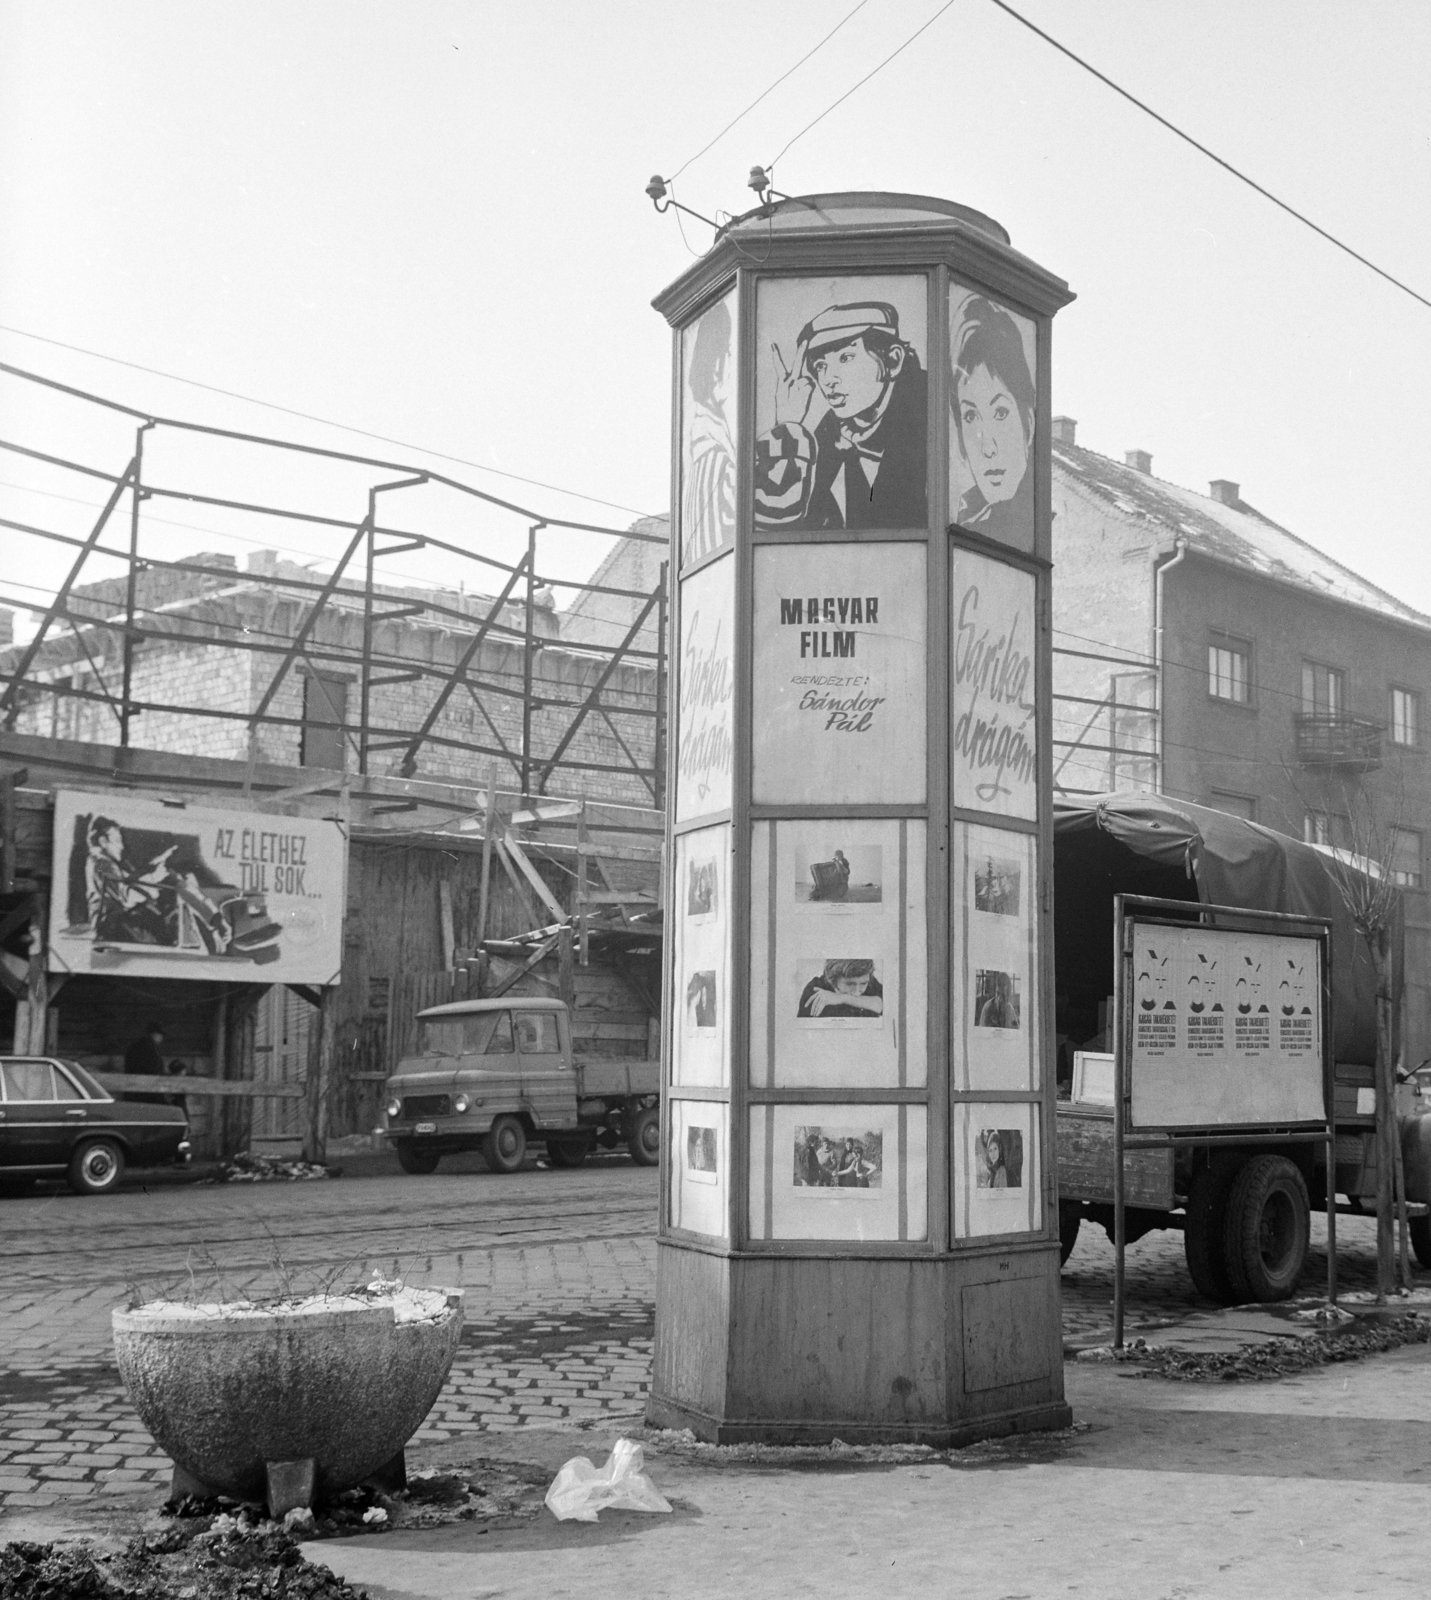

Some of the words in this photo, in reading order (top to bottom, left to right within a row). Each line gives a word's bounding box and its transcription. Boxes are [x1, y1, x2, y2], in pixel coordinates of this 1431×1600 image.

[780, 597, 879, 625] MAGYAR
[800, 631, 856, 658] FILM
[790, 675, 870, 687] RENDEZTE:
[798, 690, 886, 712] Sándor
[824, 711, 874, 733] Pál
[213, 828, 236, 859] AZ
[274, 865, 322, 900] SOK...
